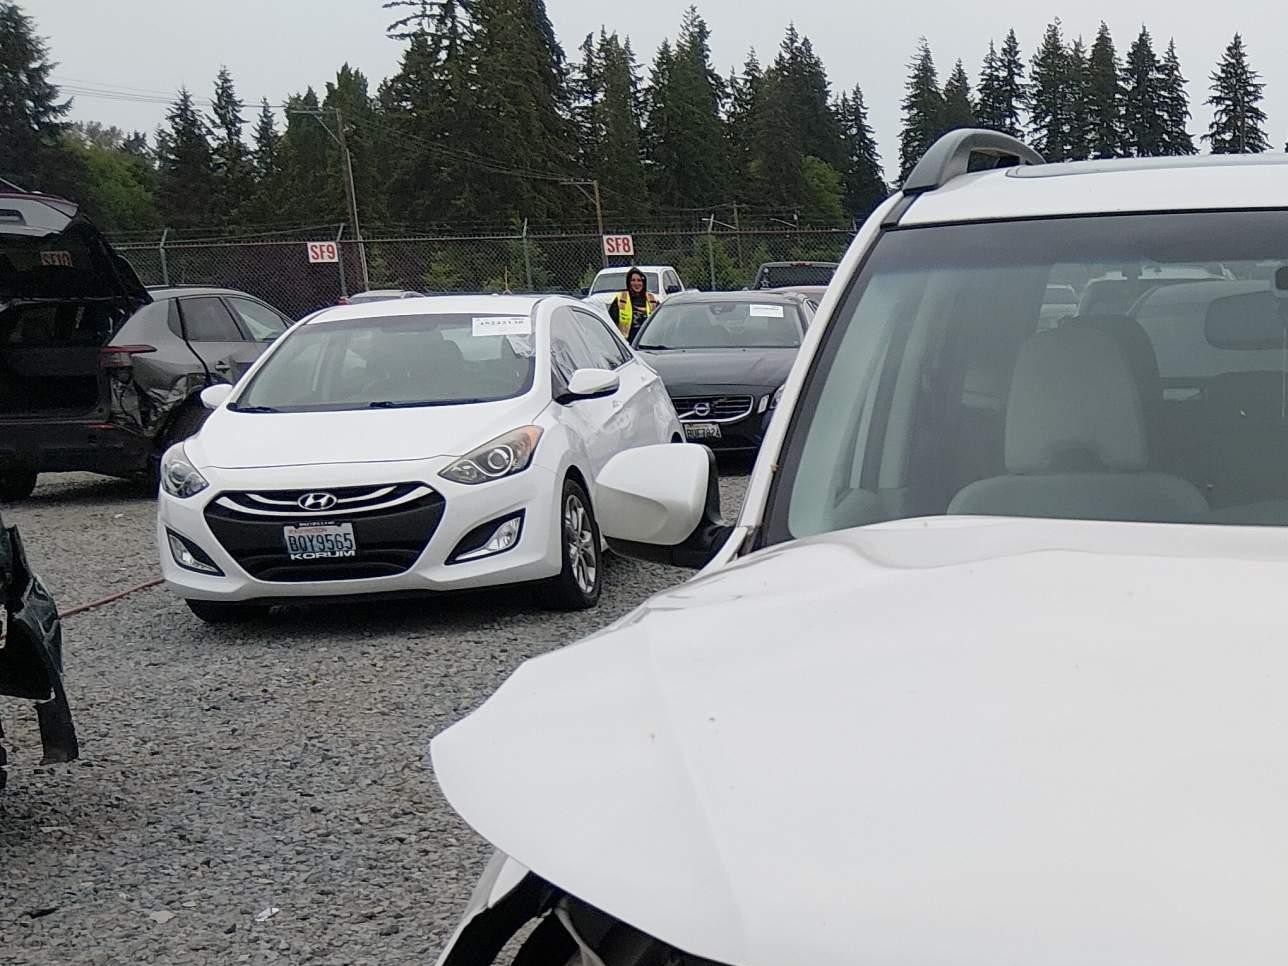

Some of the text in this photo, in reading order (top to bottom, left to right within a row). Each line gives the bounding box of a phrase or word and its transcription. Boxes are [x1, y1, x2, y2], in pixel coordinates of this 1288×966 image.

[310, 244, 335, 260] SF9
[606, 237, 631, 253] SF8
[290, 550, 355, 560] KORUM
